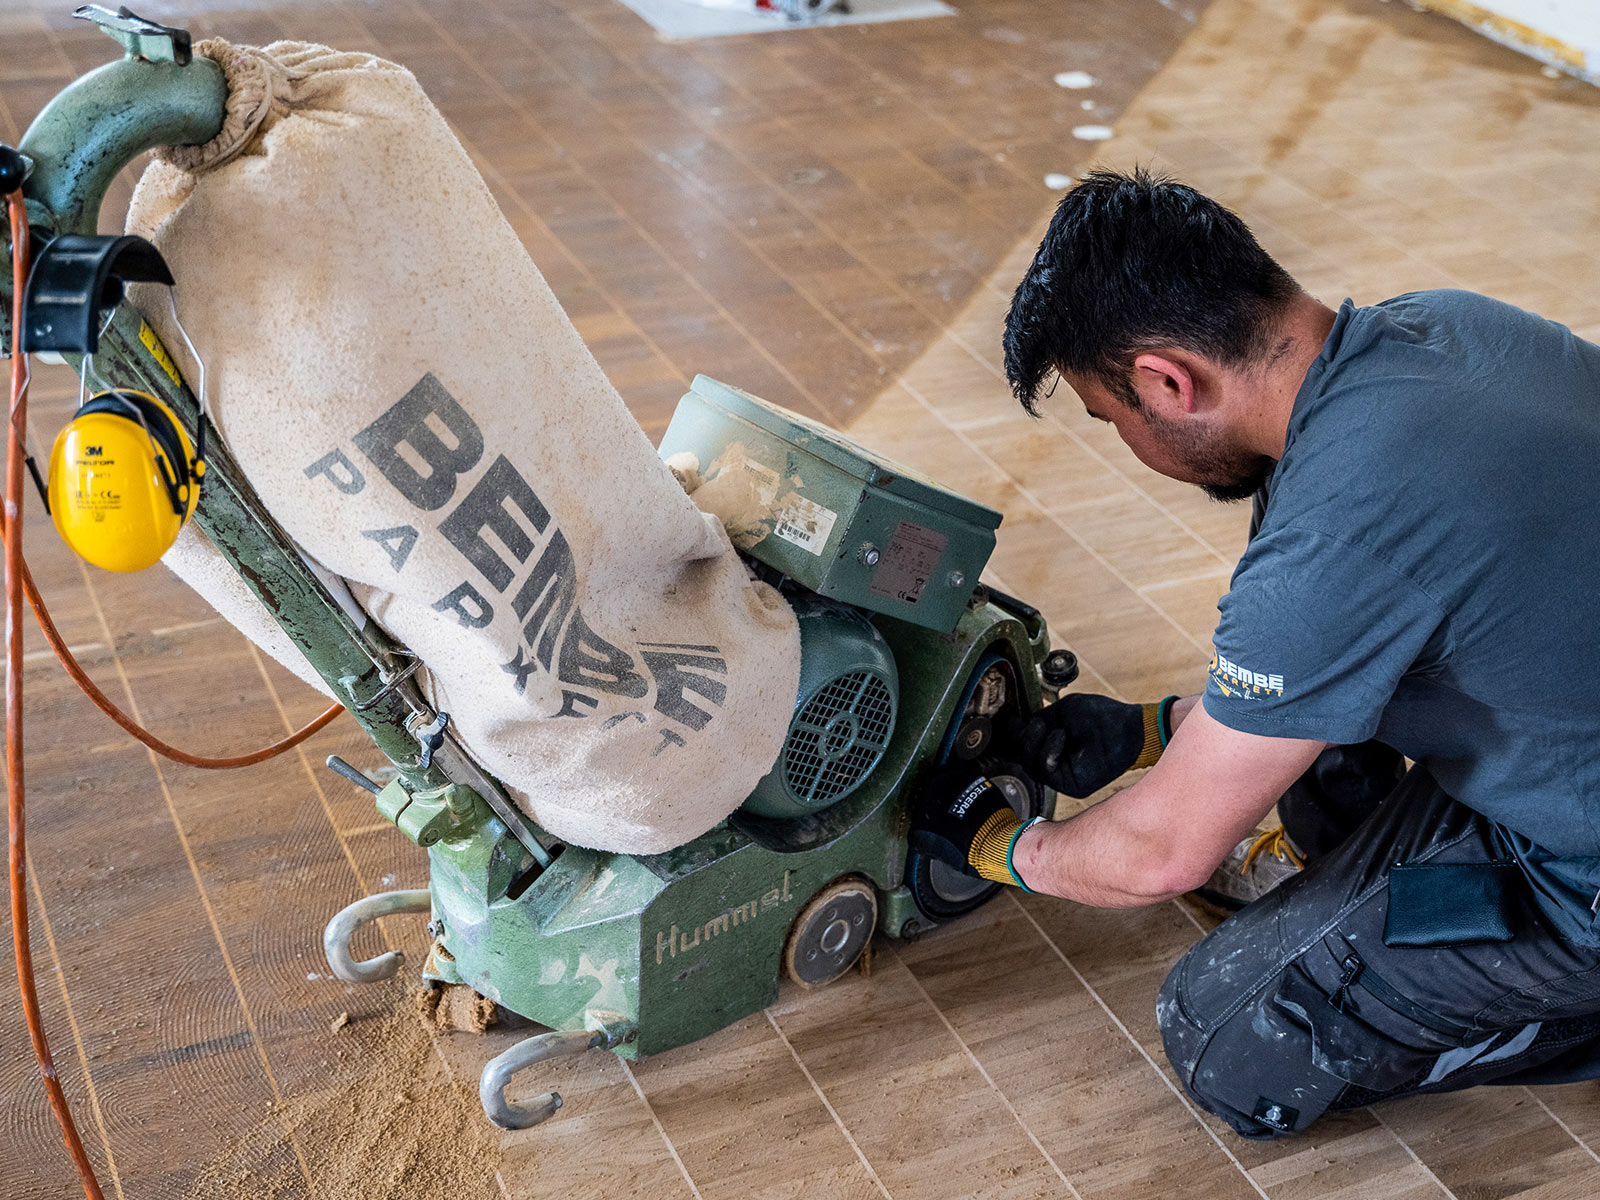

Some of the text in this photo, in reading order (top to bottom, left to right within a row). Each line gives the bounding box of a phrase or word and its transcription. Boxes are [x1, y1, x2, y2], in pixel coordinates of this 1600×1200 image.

[85, 446, 103, 456] 3M
[1216, 668, 1284, 697] PARKETT
[956, 784, 988, 815] TEGERA
[656, 869, 793, 964] Hummel
